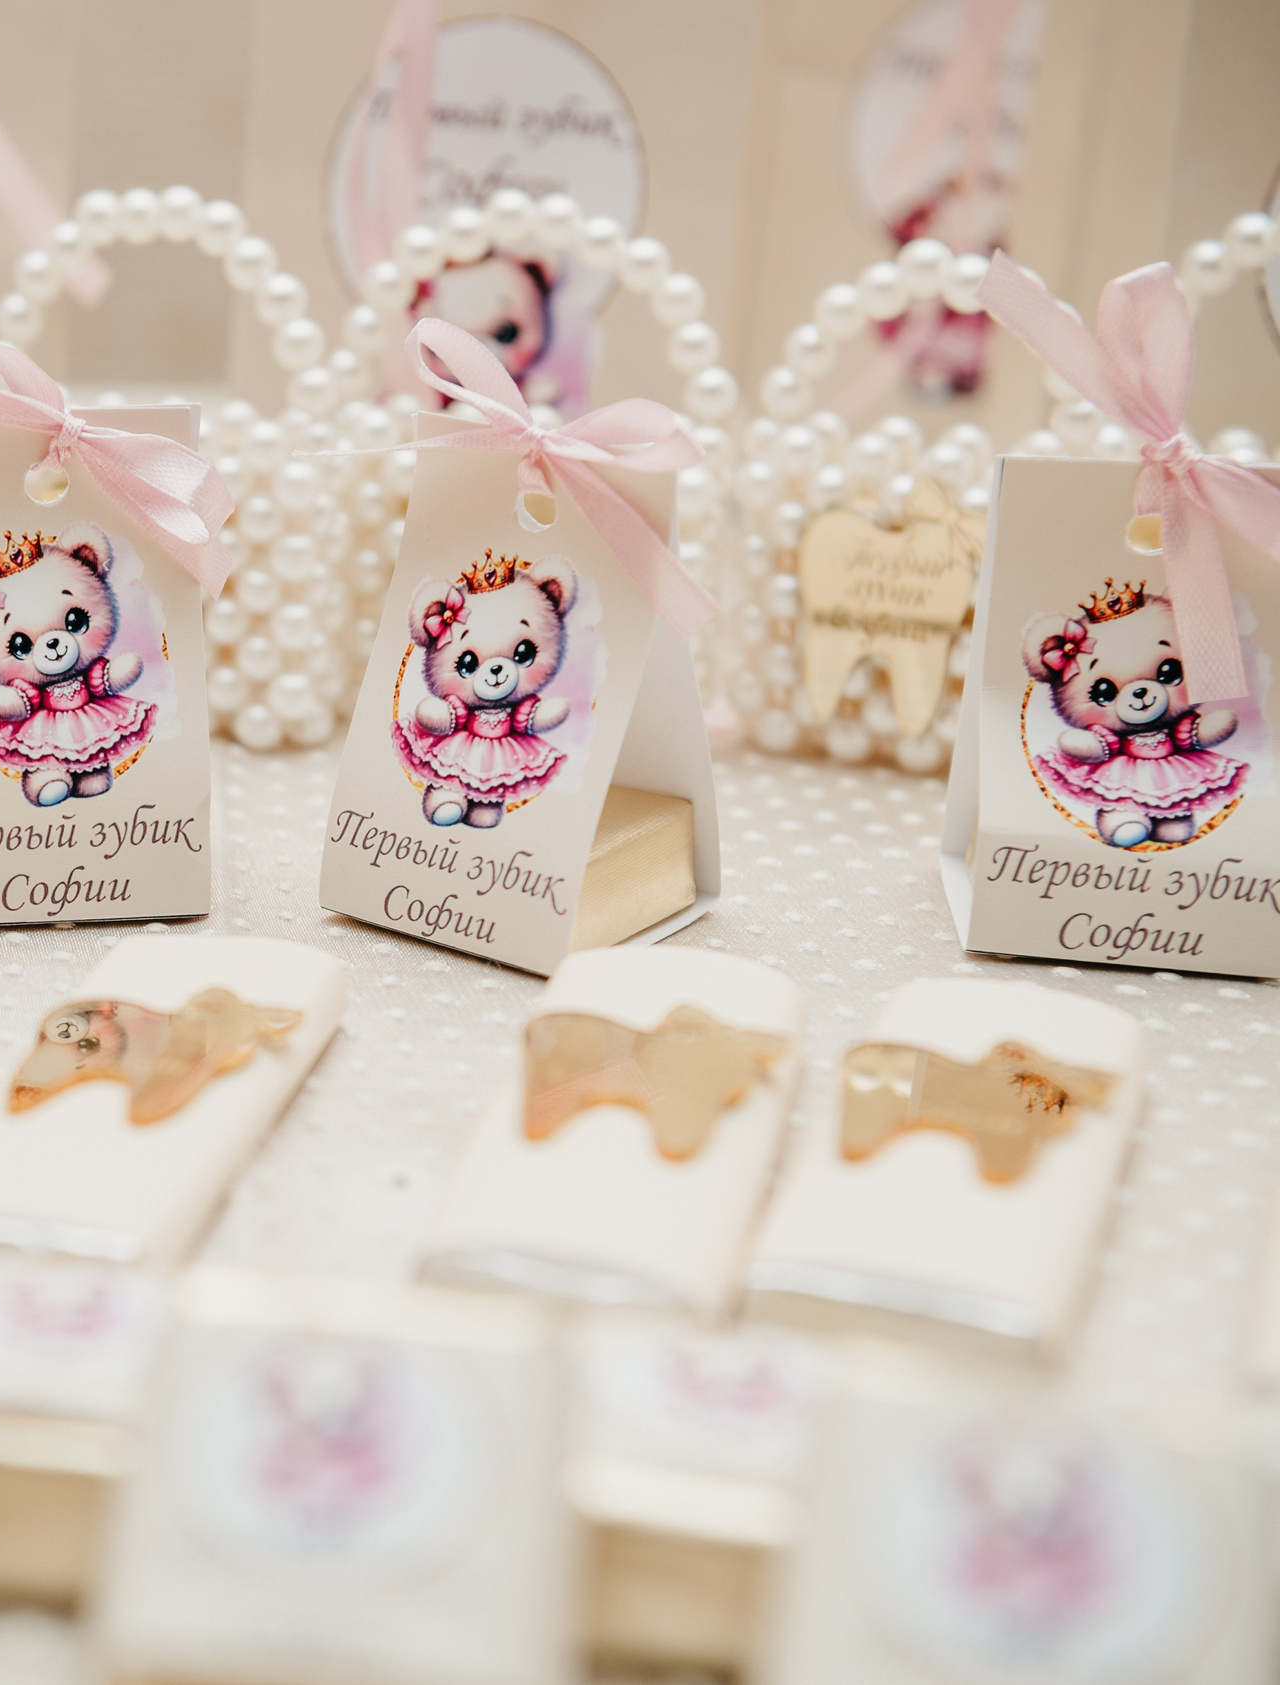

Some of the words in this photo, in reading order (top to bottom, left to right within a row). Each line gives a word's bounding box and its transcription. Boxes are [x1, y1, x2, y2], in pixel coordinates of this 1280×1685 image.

[90, 804, 202, 860] зубик
[1, 866, 131, 916] Софии
[331, 810, 461, 873] Первый
[467, 851, 566, 915] зубик
[987, 844, 1152, 899] Первый
[1164, 858, 1280, 914] зубик
[384, 885, 496, 943] Софии
[1058, 912, 1204, 961] Софии
